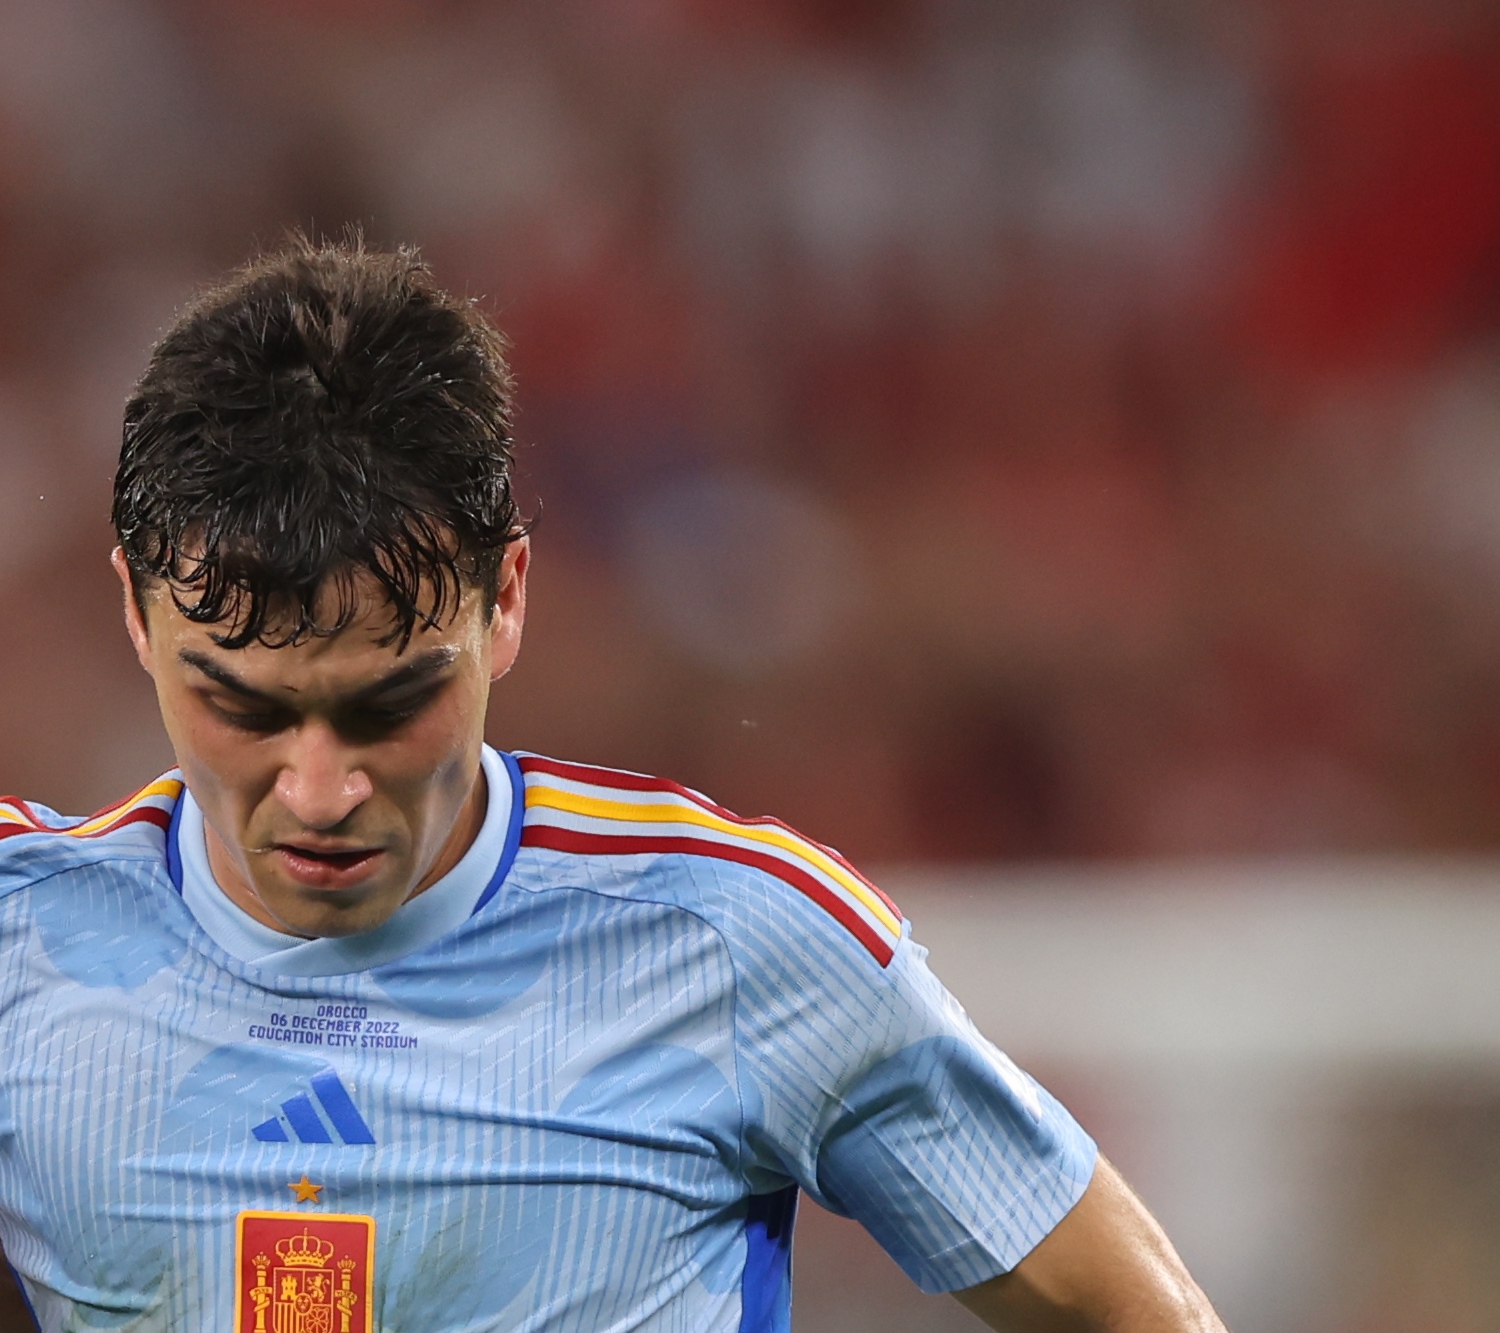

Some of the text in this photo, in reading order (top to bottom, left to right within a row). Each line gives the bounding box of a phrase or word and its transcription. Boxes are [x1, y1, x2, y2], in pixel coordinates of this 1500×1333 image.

[270, 1013, 400, 1034] 06 DECEMBER 2022
[248, 1025, 418, 1049] EDUCATION CITY STADIUM
